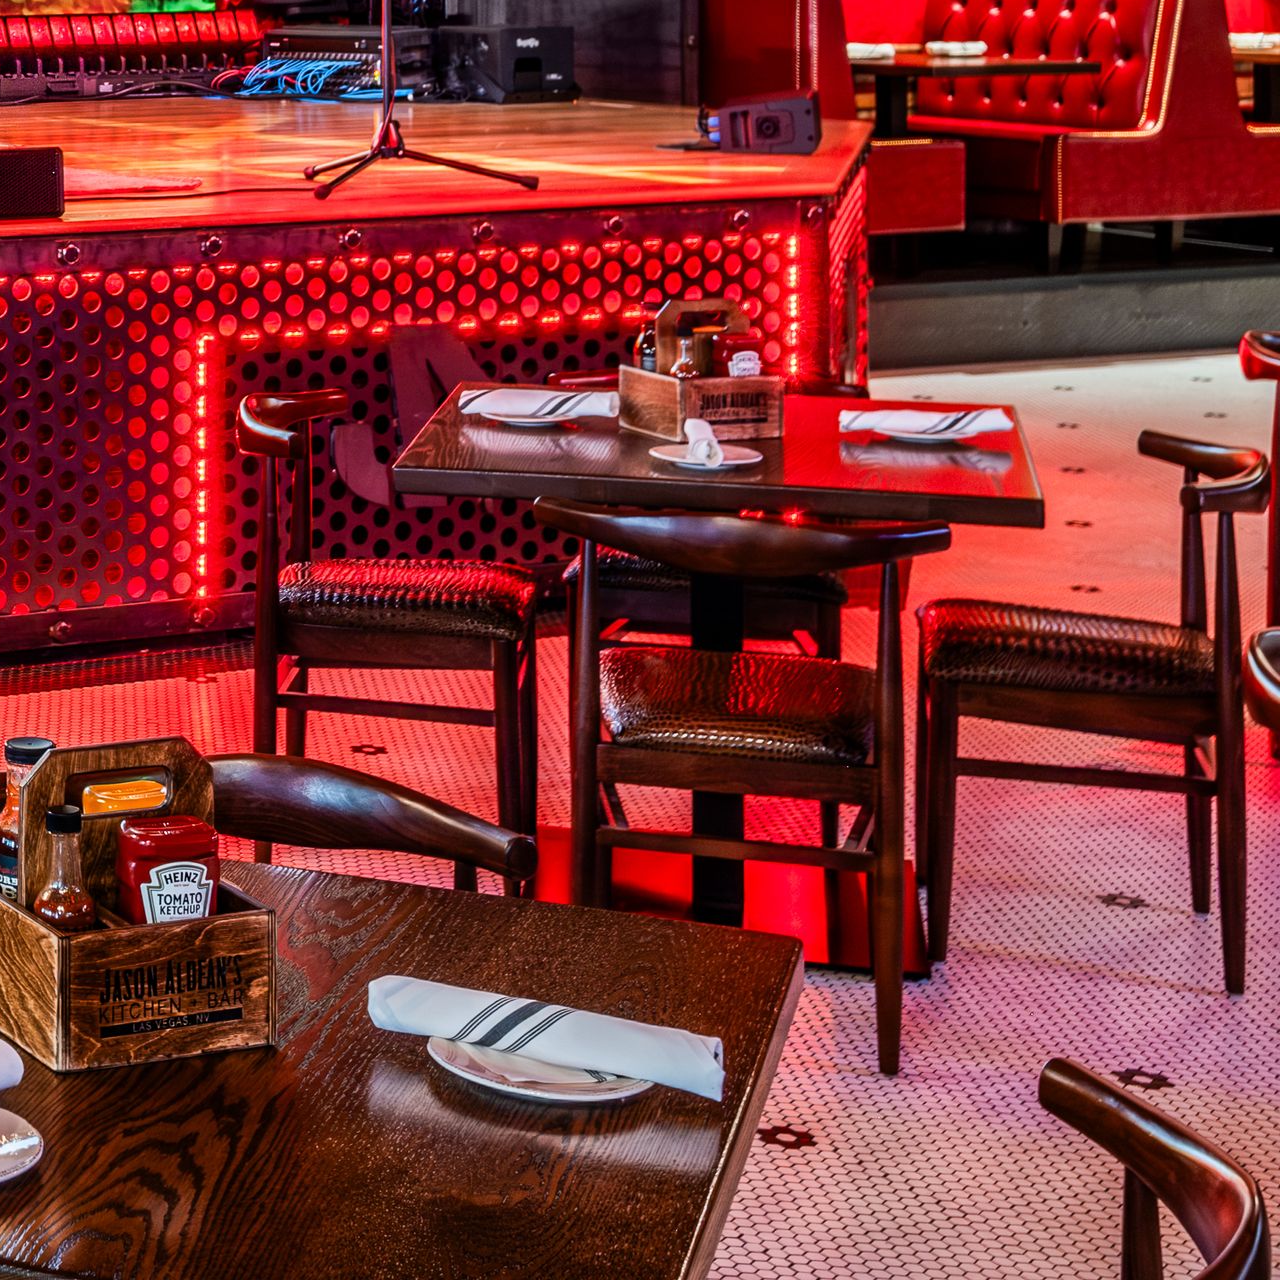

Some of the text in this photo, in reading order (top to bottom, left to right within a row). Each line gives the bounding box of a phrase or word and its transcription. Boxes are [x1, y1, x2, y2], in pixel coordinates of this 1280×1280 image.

[164, 871, 199, 885] HEINZ
[157, 892, 202, 905] TOMATO
[159, 904, 201, 915] KETCHUP
[99, 955, 242, 1004] JASON ALDEAN'S
[98, 996, 182, 1024] KITCHEN
[207, 988, 244, 1009] BAR
[132, 1023, 152, 1033] LAS
[196, 1013, 210, 1024] NV
